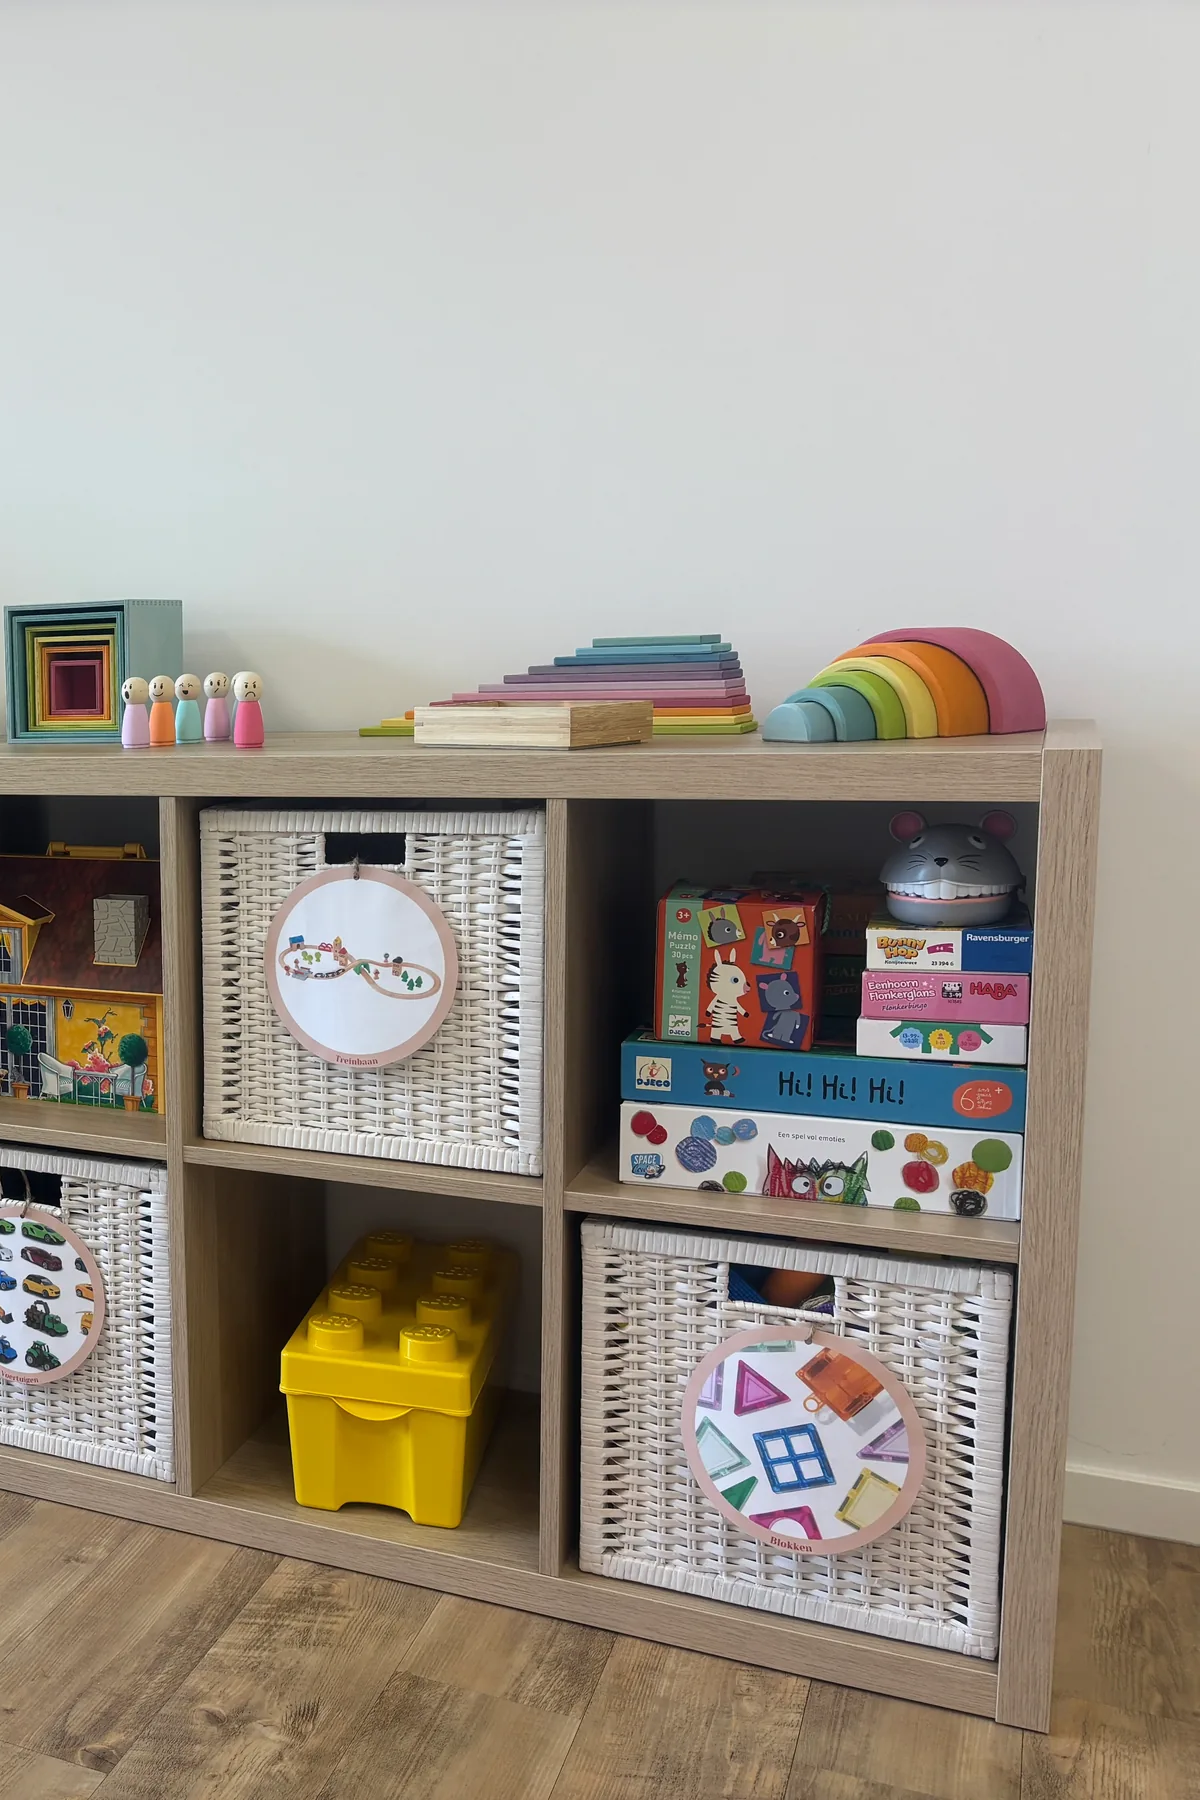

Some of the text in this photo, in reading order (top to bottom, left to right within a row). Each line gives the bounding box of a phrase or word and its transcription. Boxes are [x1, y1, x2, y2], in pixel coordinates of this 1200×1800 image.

[677, 911, 690, 920] 3+
[668, 931, 699, 942] Mémo
[877, 933, 1030, 951] Bunny Ravensburger
[669, 942, 697, 951] Puzzle
[671, 951, 681, 959] 30
[885, 946, 919, 960] Hop
[867, 980, 919, 990] Eenhoorn
[969, 981, 1018, 1001] HABA
[869, 988, 936, 1001] Flonkerglans
[882, 1002, 928, 1012] Flonkerbingo
[336, 1054, 379, 1066] Treinbaan
[636, 1078, 671, 1088] DJECO
[778, 1070, 905, 1105] Hi! Hi! Hi!
[960, 1087, 975, 1111] 6
[791, 1132, 806, 1140] spel
[818, 1135, 846, 1143] emoties
[633, 1154, 658, 1165] SPACE
[312, 1315, 359, 1328] LEGO
[404, 1326, 451, 1338] LEGO
[1, 1370, 39, 1384] Voertuigen
[770, 1536, 813, 1552] Blokken
